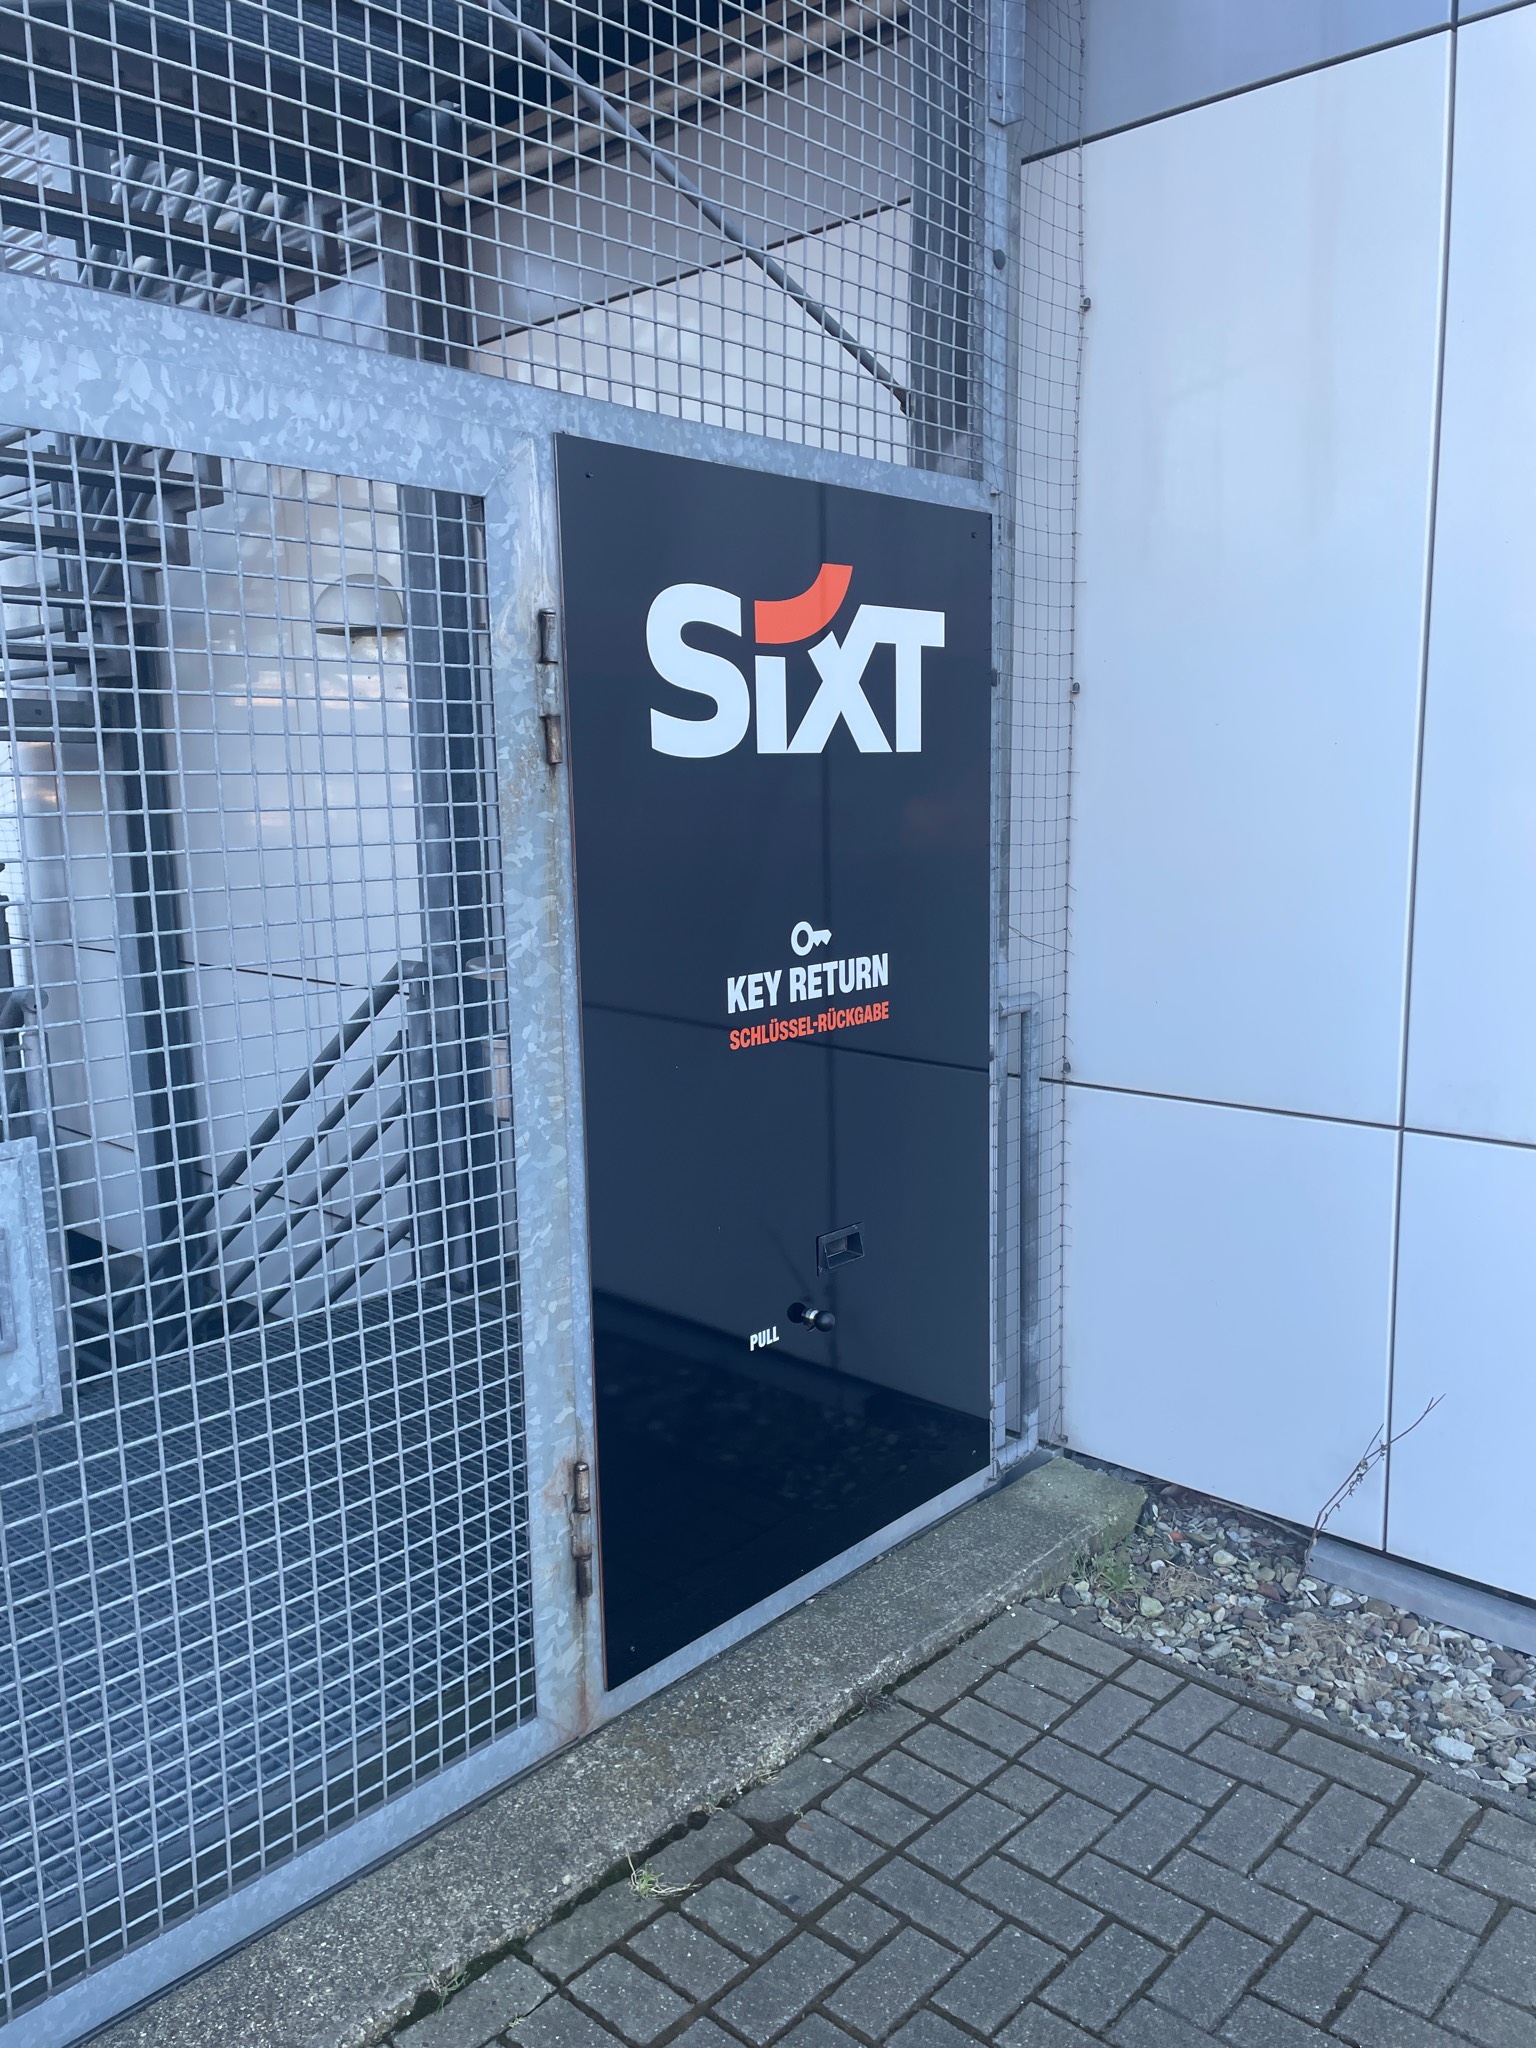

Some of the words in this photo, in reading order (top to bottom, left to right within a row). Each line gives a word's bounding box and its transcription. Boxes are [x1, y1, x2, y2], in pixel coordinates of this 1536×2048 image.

[726, 969, 783, 1015] KEY
[789, 952, 889, 1003] RETURN
[729, 1000, 890, 1051] SCHLÜSSEL-RÜCKGABE
[749, 1325, 780, 1352] PULL
